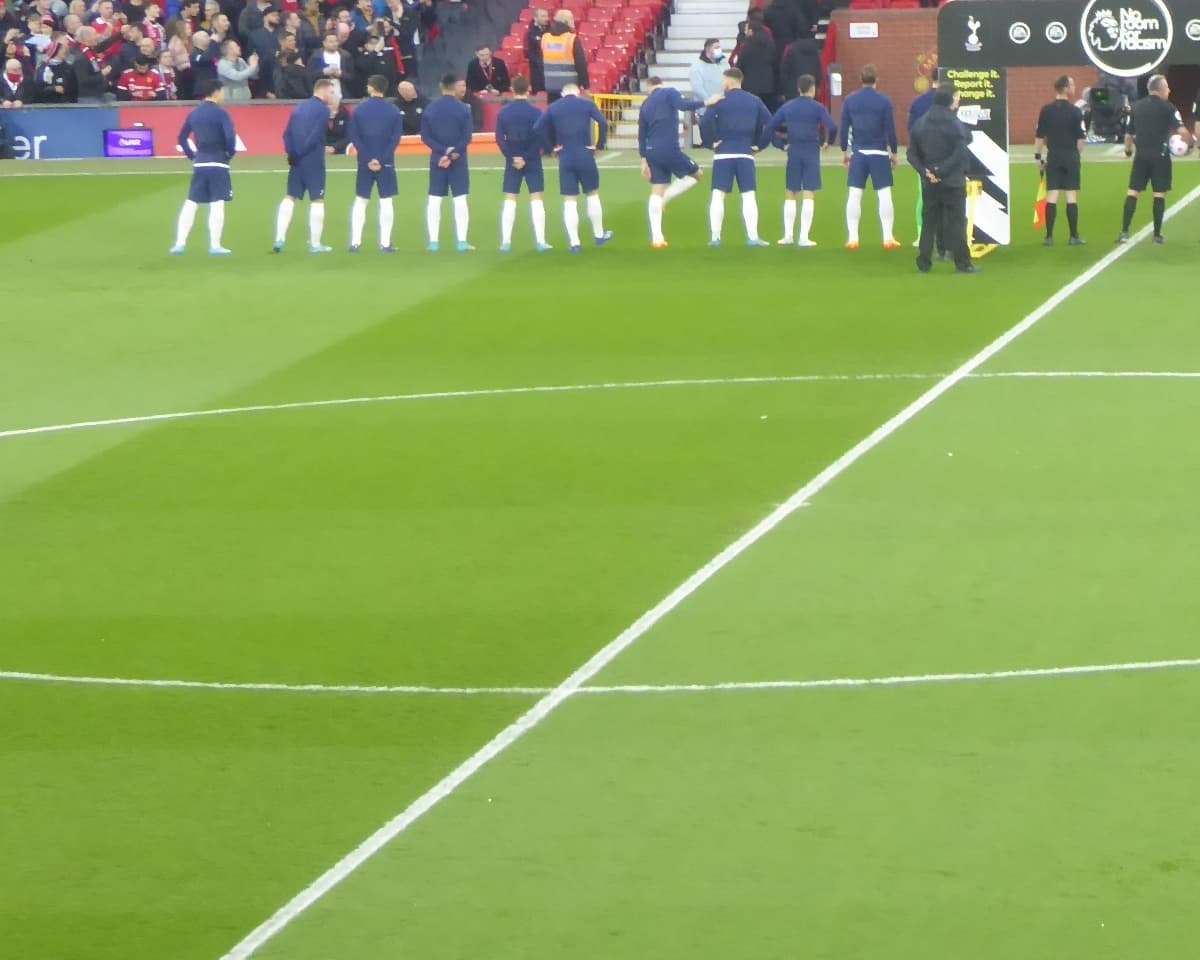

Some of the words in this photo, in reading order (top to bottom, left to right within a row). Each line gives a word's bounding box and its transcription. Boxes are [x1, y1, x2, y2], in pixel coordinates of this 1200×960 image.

[1119, 7, 1142, 20] No
[1120, 18, 1159, 30] room
[1120, 38, 1167, 51] racism
[947, 70, 989, 80] Challenge
[957, 90, 985, 100] hange
